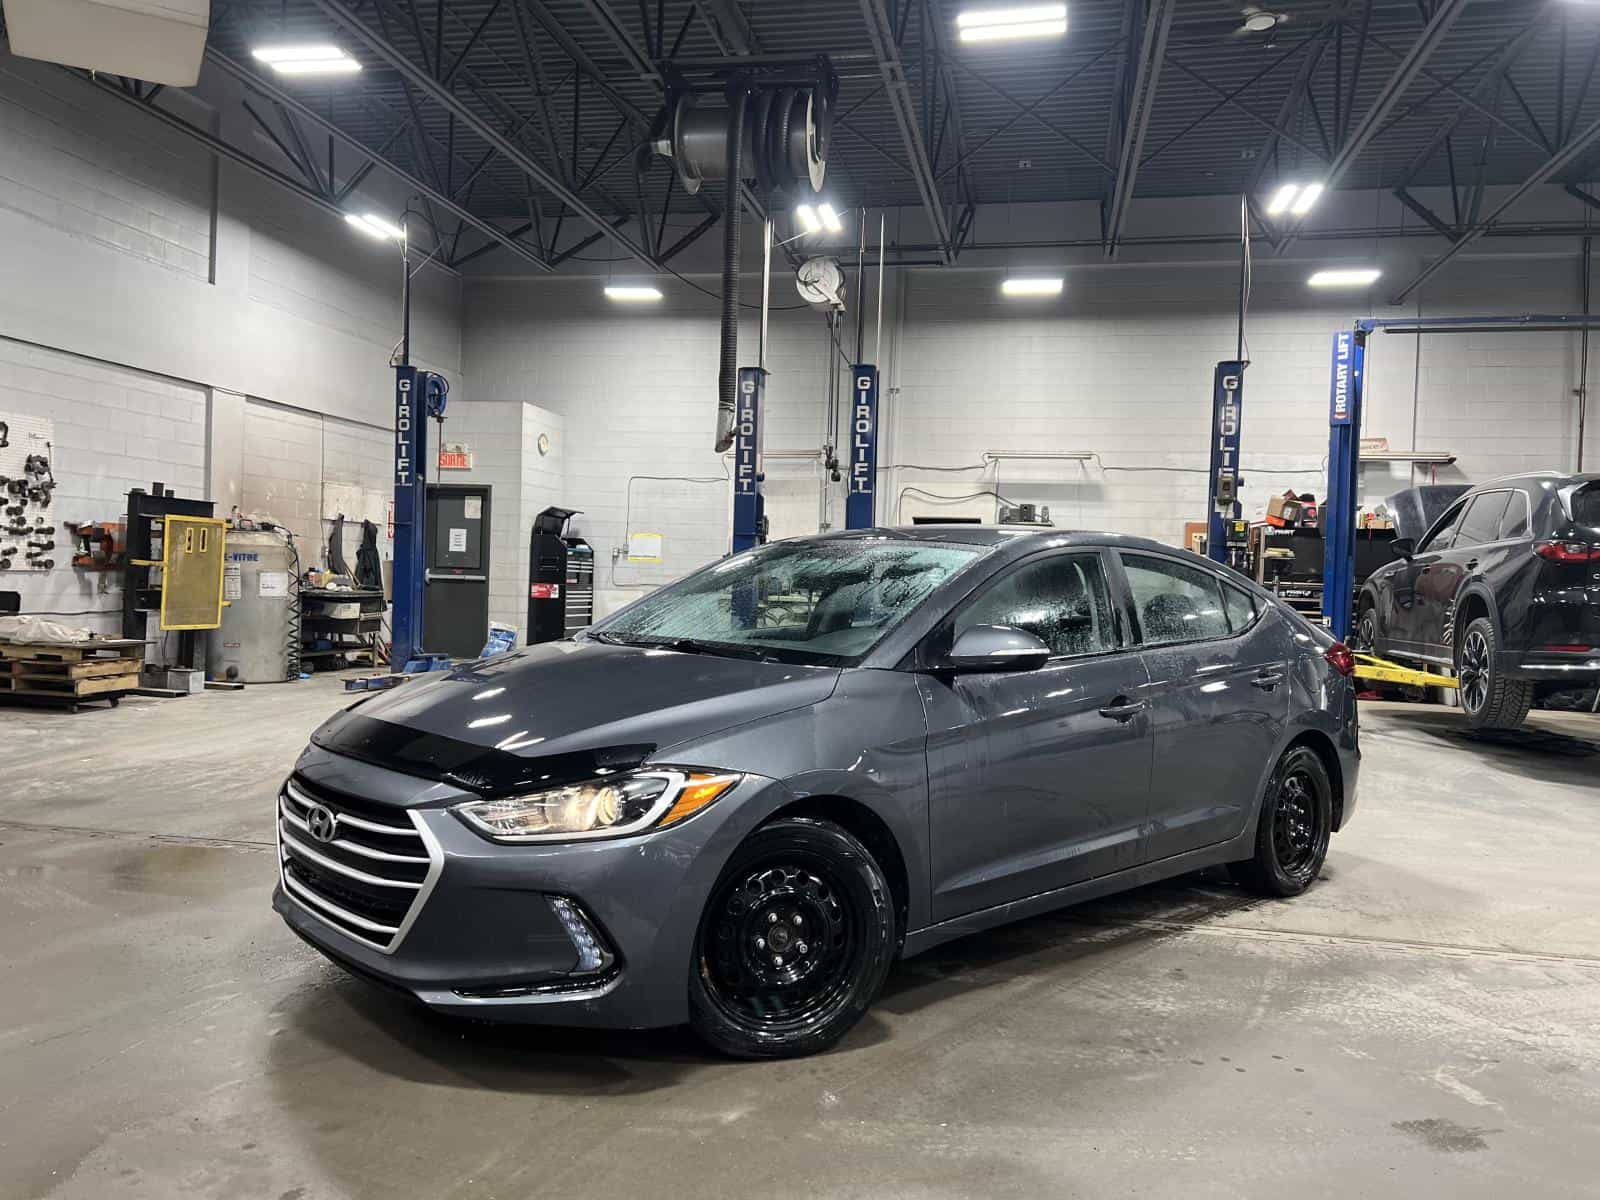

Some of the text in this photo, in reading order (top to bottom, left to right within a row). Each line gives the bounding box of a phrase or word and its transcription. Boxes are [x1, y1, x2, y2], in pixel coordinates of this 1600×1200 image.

[1335, 333, 1350, 412] ROTARY LIFT
[398, 379, 411, 484] GIROLIFT
[739, 381, 755, 491] GIROLIFT
[854, 376, 871, 491] GIROLIFT
[1219, 375, 1239, 478] GIROLIF
